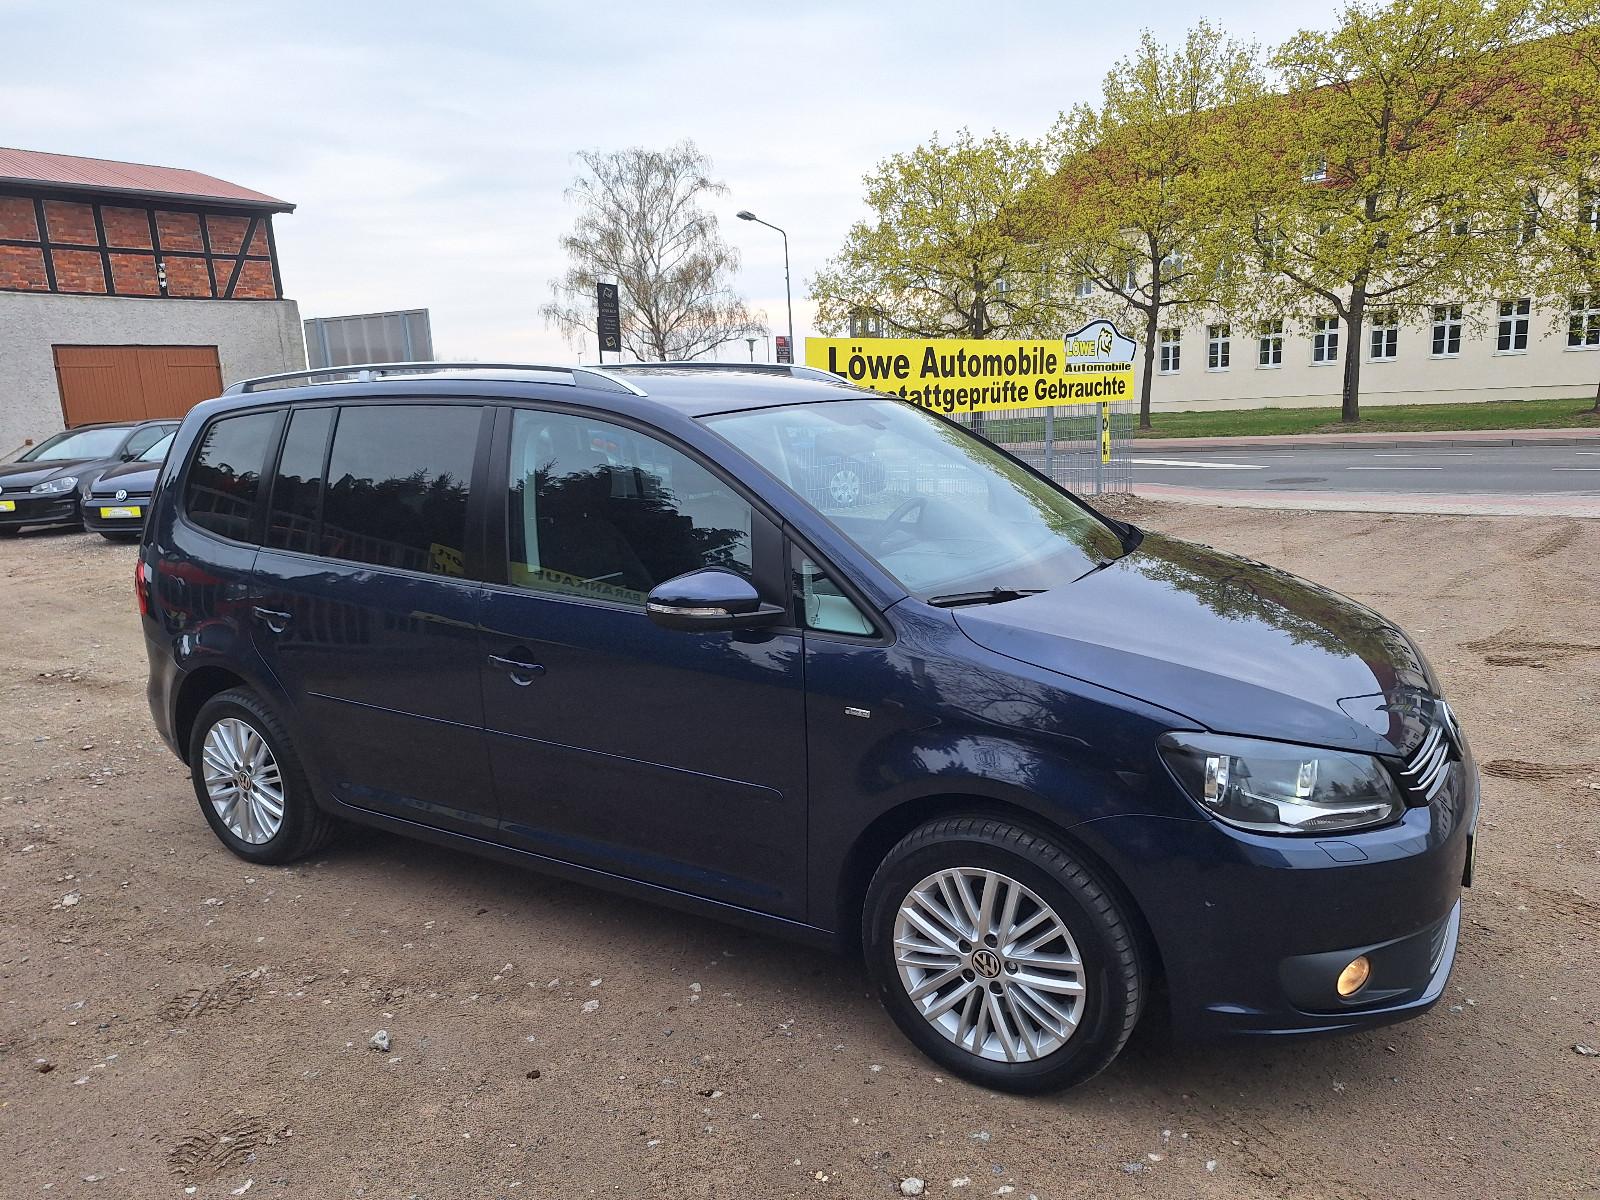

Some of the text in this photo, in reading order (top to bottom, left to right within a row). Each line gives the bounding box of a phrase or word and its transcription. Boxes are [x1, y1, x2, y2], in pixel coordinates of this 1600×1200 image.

[1066, 337, 1096, 357] LÖWE
[829, 347, 1057, 380] Löwe Automobile
[1065, 363, 1131, 373] Automobile
[1034, 376, 1126, 401] Gebrauchte
